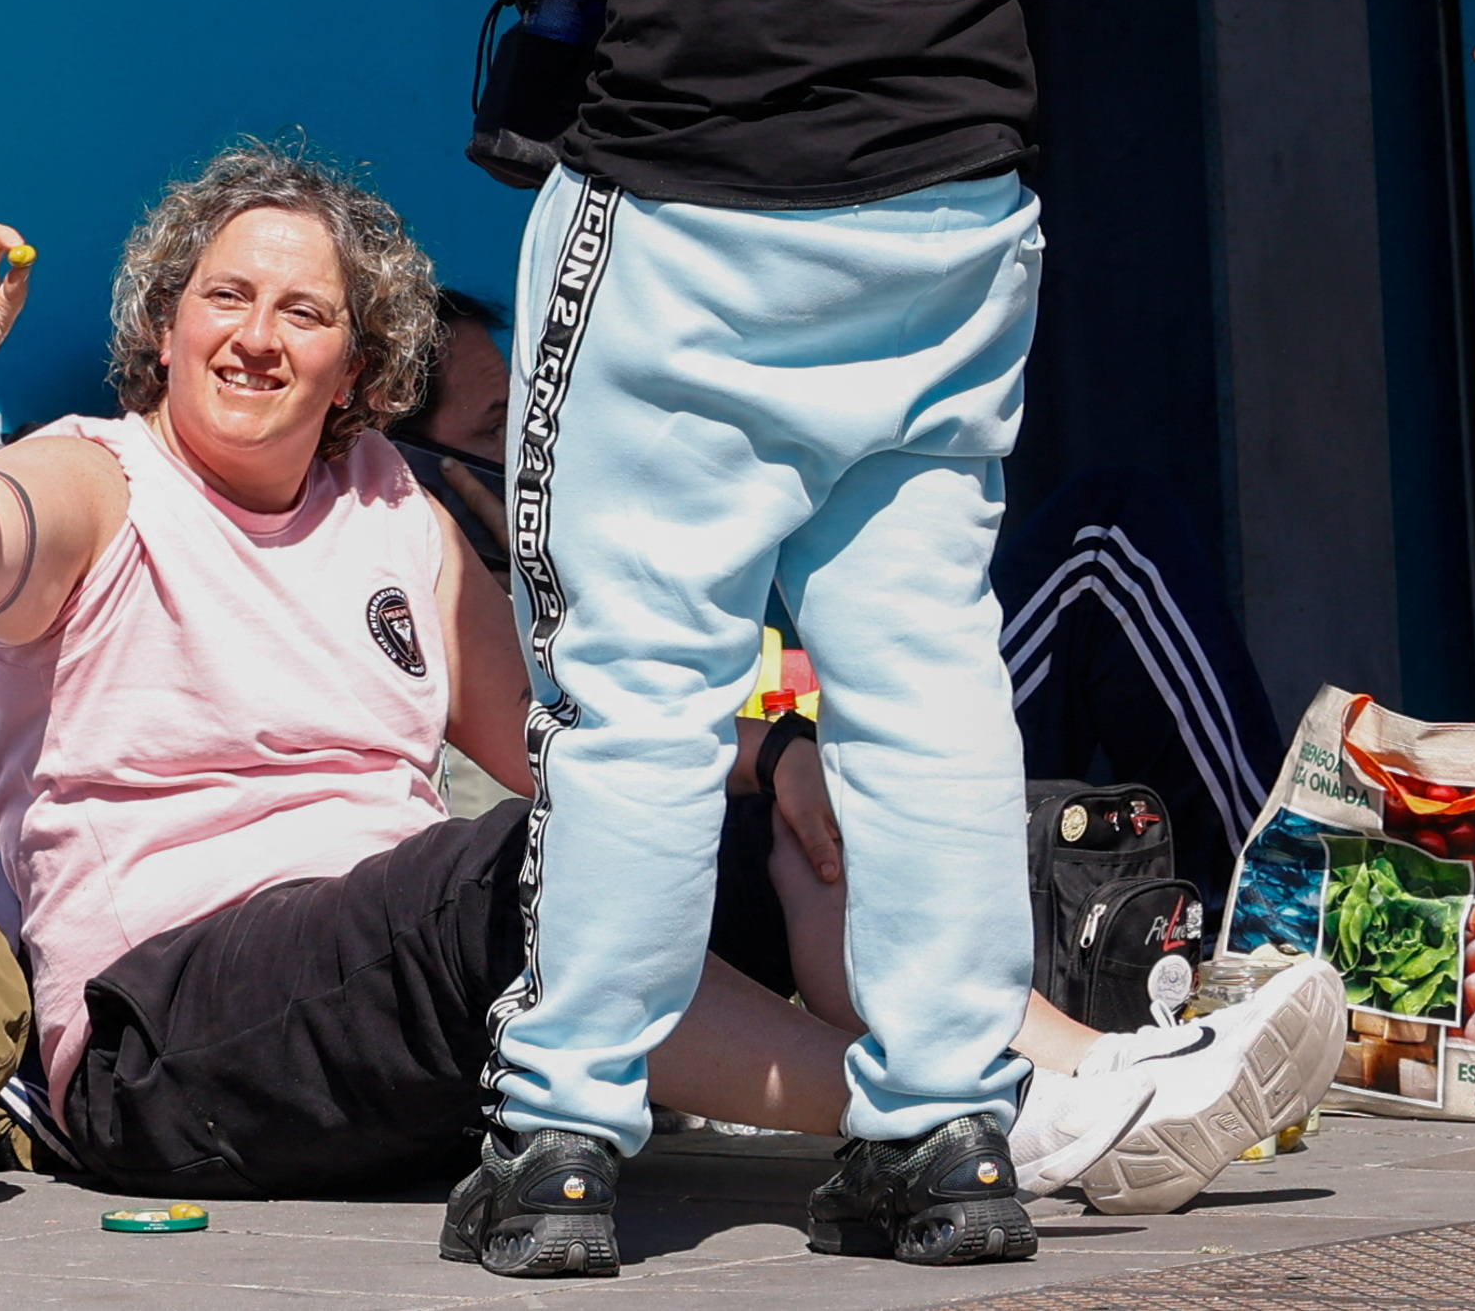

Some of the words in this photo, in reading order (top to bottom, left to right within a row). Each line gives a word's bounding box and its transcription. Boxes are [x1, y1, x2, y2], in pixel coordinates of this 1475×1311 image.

[559, 189, 609, 290] ICON
[551, 294, 579, 328] 2
[518, 489, 550, 584] ICON
[1309, 772, 1342, 802] ONA
[1344, 784, 1372, 810] DA
